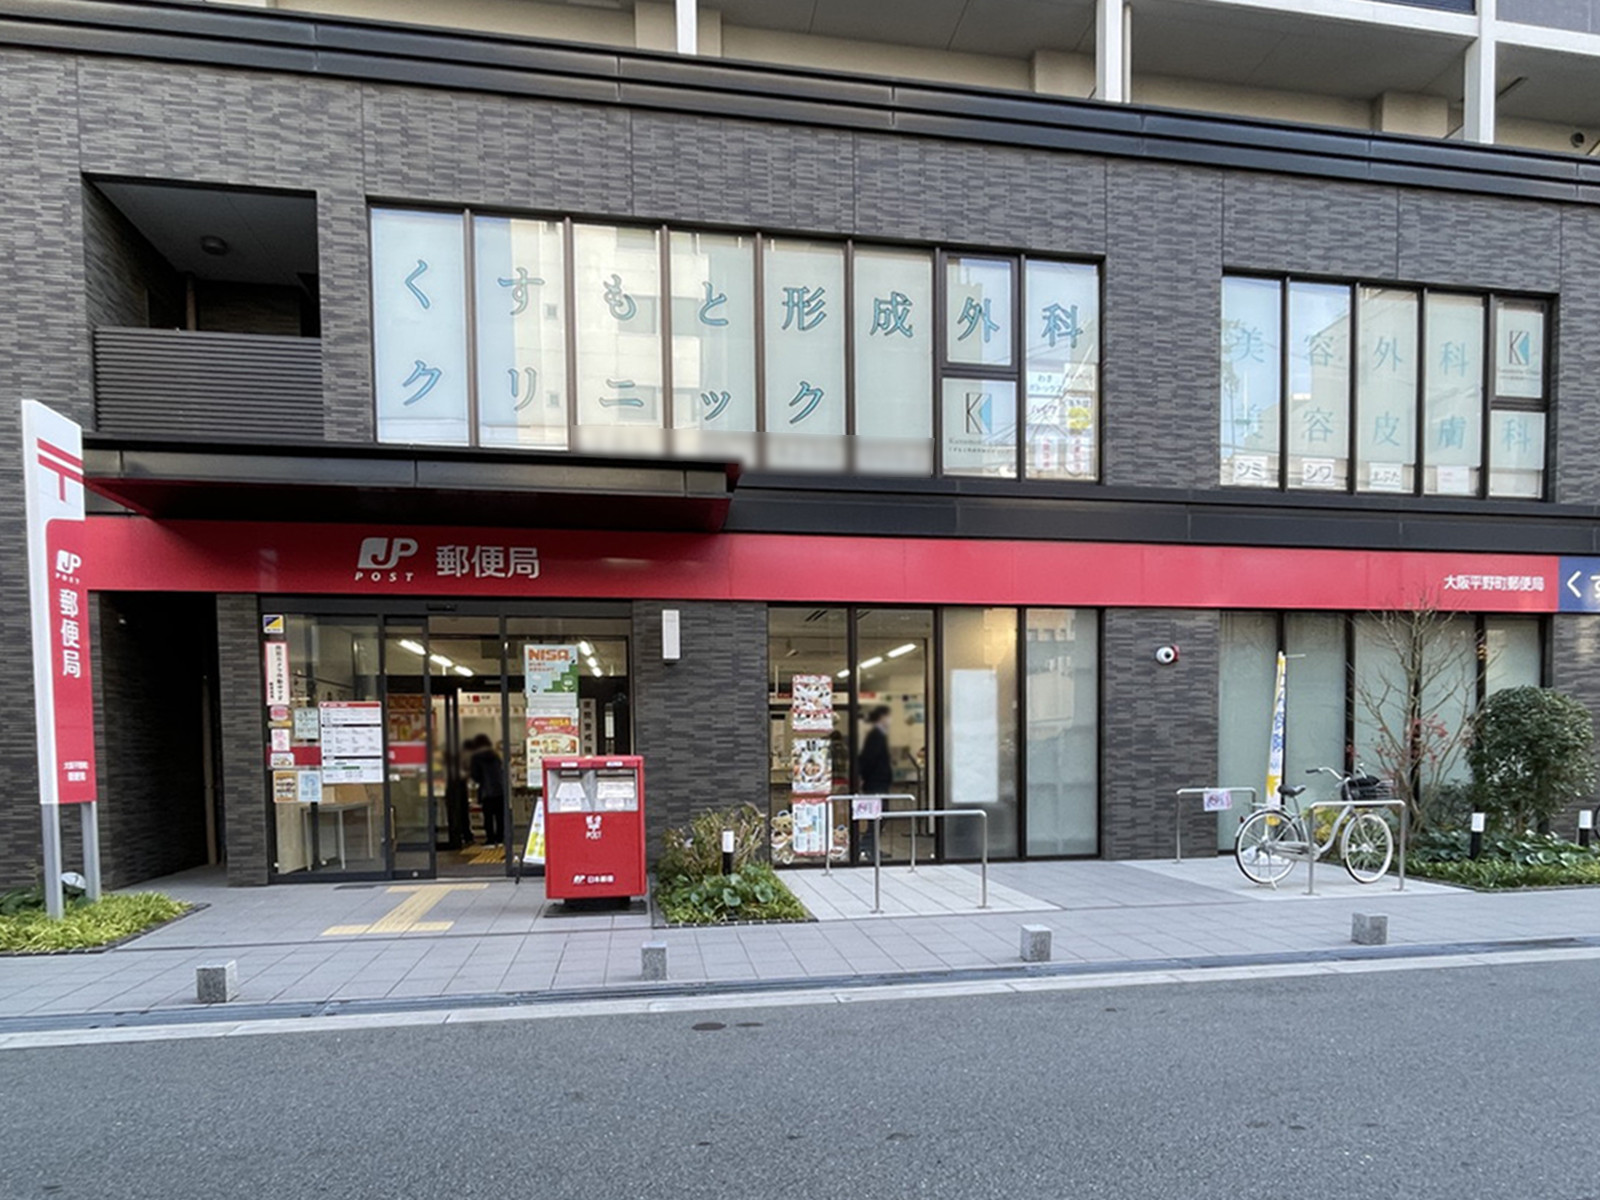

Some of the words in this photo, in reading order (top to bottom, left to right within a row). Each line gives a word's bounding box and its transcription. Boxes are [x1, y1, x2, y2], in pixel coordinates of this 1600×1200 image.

[404, 259, 1083, 350] くすもと形成外科
[1233, 326, 1470, 377] 美容外科
[402, 359, 825, 425] クリニック
[1234, 403, 1532, 454] 美容皮膚科
[1236, 461, 1264, 479] シミ
[1305, 463, 1333, 481] シワ
[354, 571, 415, 583] POST
[435, 544, 541, 580] 郵便局
[1443, 574, 1546, 593] 大阪平野町郵便局
[59, 588, 82, 680] 郵便局
[528, 649, 570, 661] NISA
